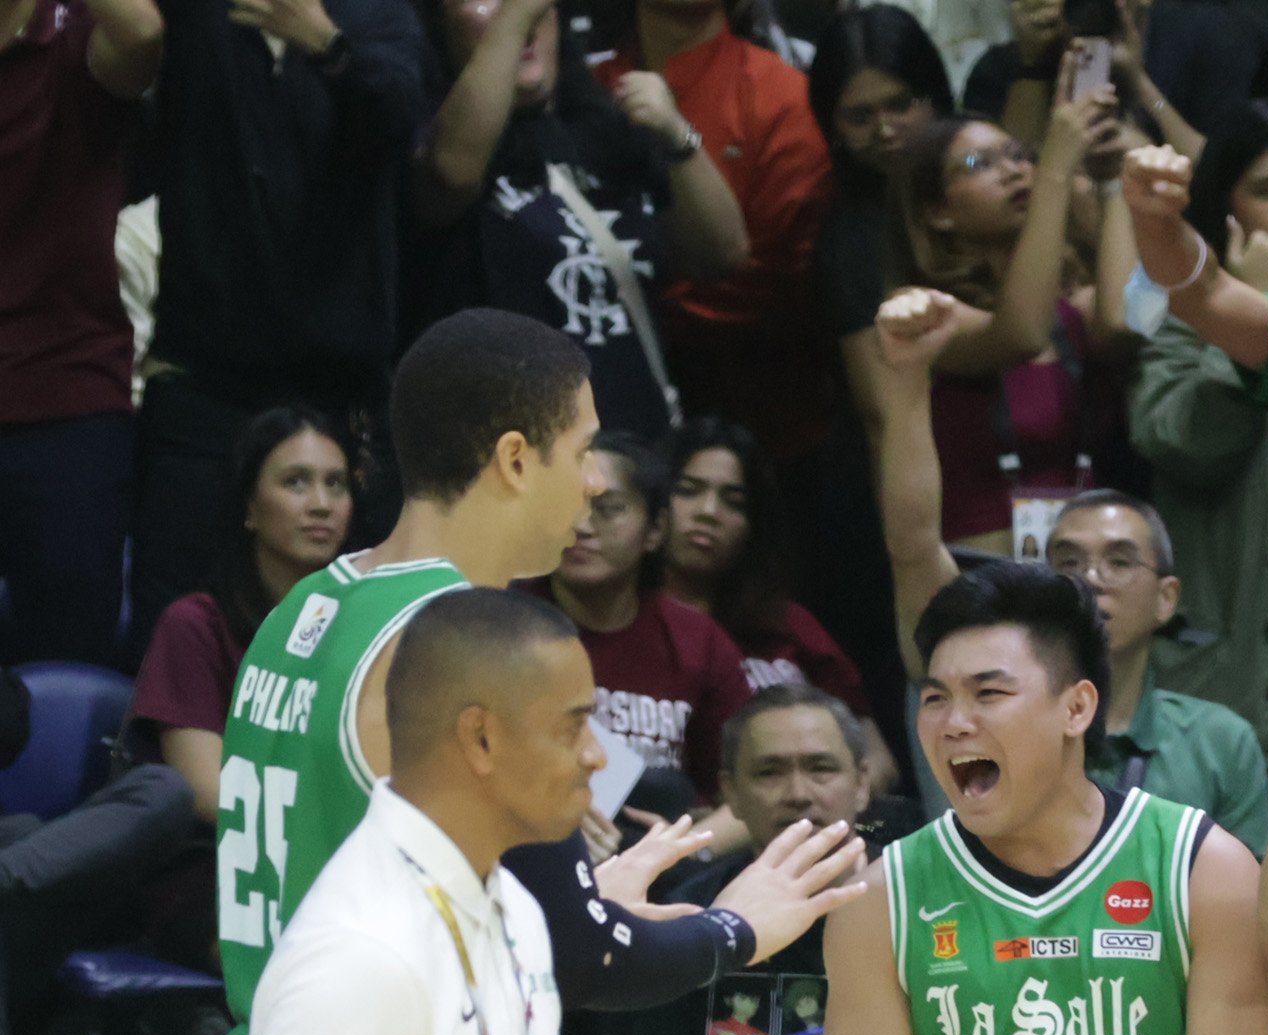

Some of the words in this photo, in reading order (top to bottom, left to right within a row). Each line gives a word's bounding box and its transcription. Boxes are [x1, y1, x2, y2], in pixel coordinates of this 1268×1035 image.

[1107, 894, 1150, 909] Gazz
[1031, 938, 1077, 954] ICTSI
[1106, 936, 1149, 948] CWC
